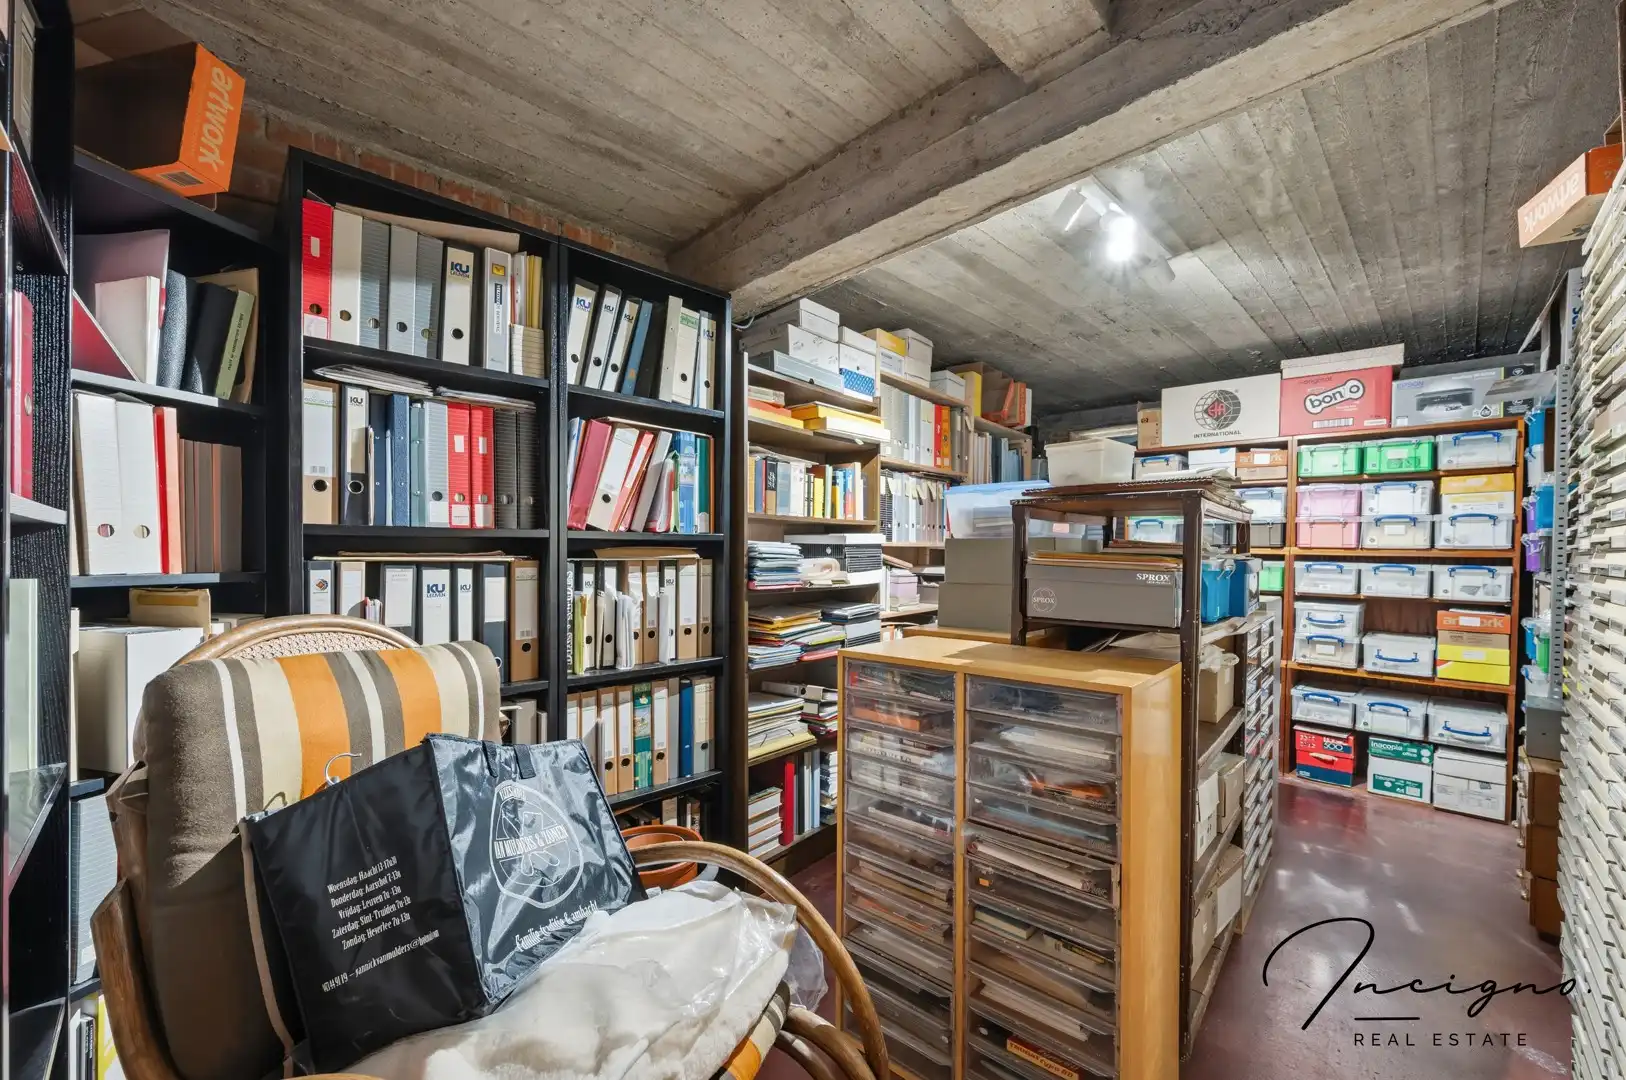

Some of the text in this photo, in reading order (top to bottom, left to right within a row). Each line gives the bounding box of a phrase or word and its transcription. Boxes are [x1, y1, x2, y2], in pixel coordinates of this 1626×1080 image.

[198, 66, 233, 173] artwork
[1523, 171, 1580, 233] artwork
[450, 261, 470, 273] KU
[576, 297, 591, 309] KU
[350, 396, 363, 404] KU
[1309, 384, 1360, 408] bono
[1193, 430, 1242, 439] INTERNATIONAL
[1136, 573, 1171, 582] SPROX
[427, 583, 446, 593] KU
[1032, 596, 1055, 604] SPROX
[1443, 616, 1505, 628] arork
[1323, 742, 1343, 751] 500
[330, 888, 364, 908] Donderdag:
[365, 875, 388, 894] Aarschot
[338, 904, 363, 920] Vrijdag:
[361, 892, 384, 910] Leuven
[331, 920, 361, 940] Zaterdag:
[359, 904, 397, 926] Sint-Truiden
[342, 933, 367, 951] Zondag:
[366, 920, 392, 939] Heverlee
